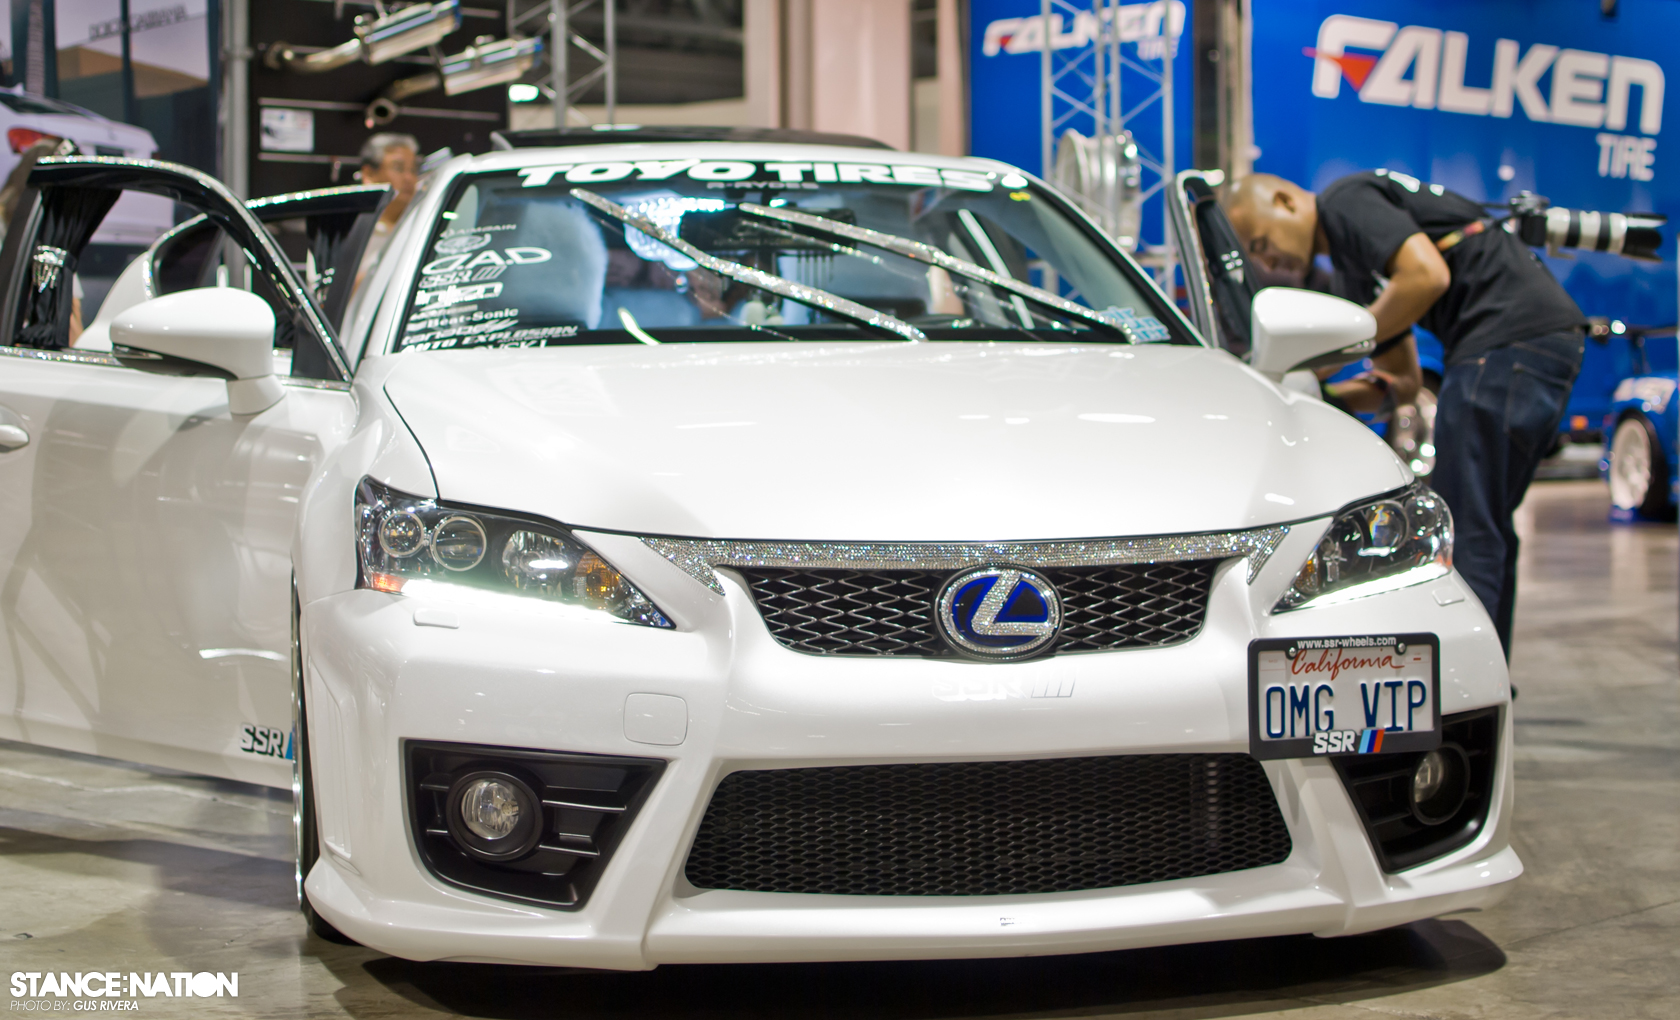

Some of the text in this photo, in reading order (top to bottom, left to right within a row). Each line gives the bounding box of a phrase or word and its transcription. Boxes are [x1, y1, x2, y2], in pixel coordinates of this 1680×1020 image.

[1311, 13, 1666, 136] FALKEN
[517, 157, 994, 192] TOYO TIRES
[1596, 132, 1658, 182] TIRE
[1297, 636, 1397, 650] www.ssr-wheels.com
[1291, 648, 1406, 681] California
[1266, 680, 1427, 739] OMG VIP
[240, 722, 284, 759] SSR
[1313, 730, 1356, 755] SSR
